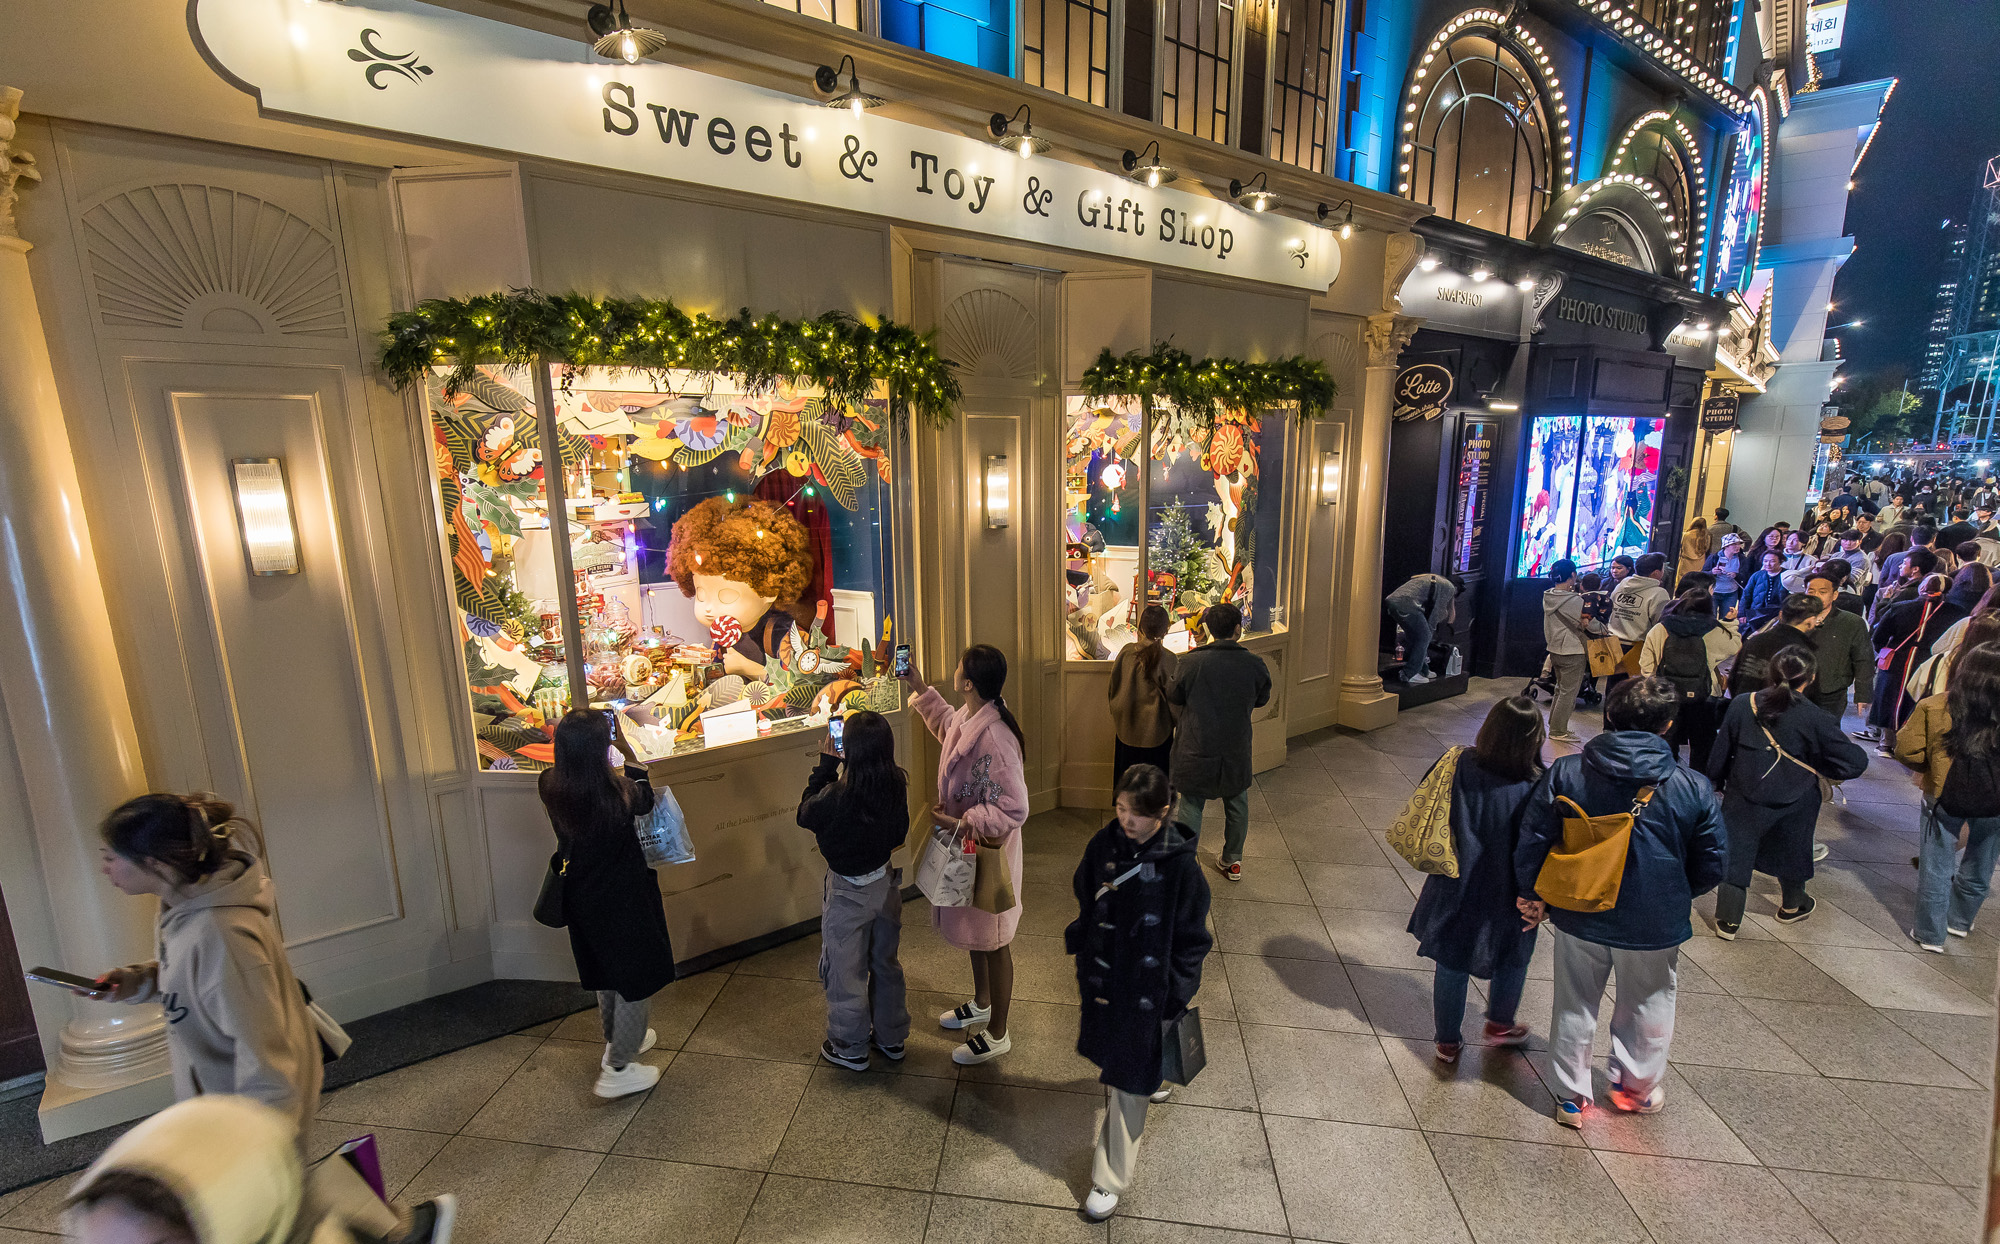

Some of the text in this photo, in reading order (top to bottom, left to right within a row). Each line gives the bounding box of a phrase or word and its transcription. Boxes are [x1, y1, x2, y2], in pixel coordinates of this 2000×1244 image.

[602, 81, 1234, 260] Sweet & Toy & Gift Shop
[1437, 286, 1483, 308] SNAPSHOT
[1558, 296, 1648, 335] PHOTO STUDIO
[1400, 372, 1443, 400] Lotte
[1706, 408, 1734, 416] PHOTO
[1705, 415, 1733, 423] STUDIO
[1468, 439, 1491, 449] PHOTO
[1467, 450, 1490, 460] STUDIO
[714, 822, 725, 832] All
[726, 820, 737, 829] the
